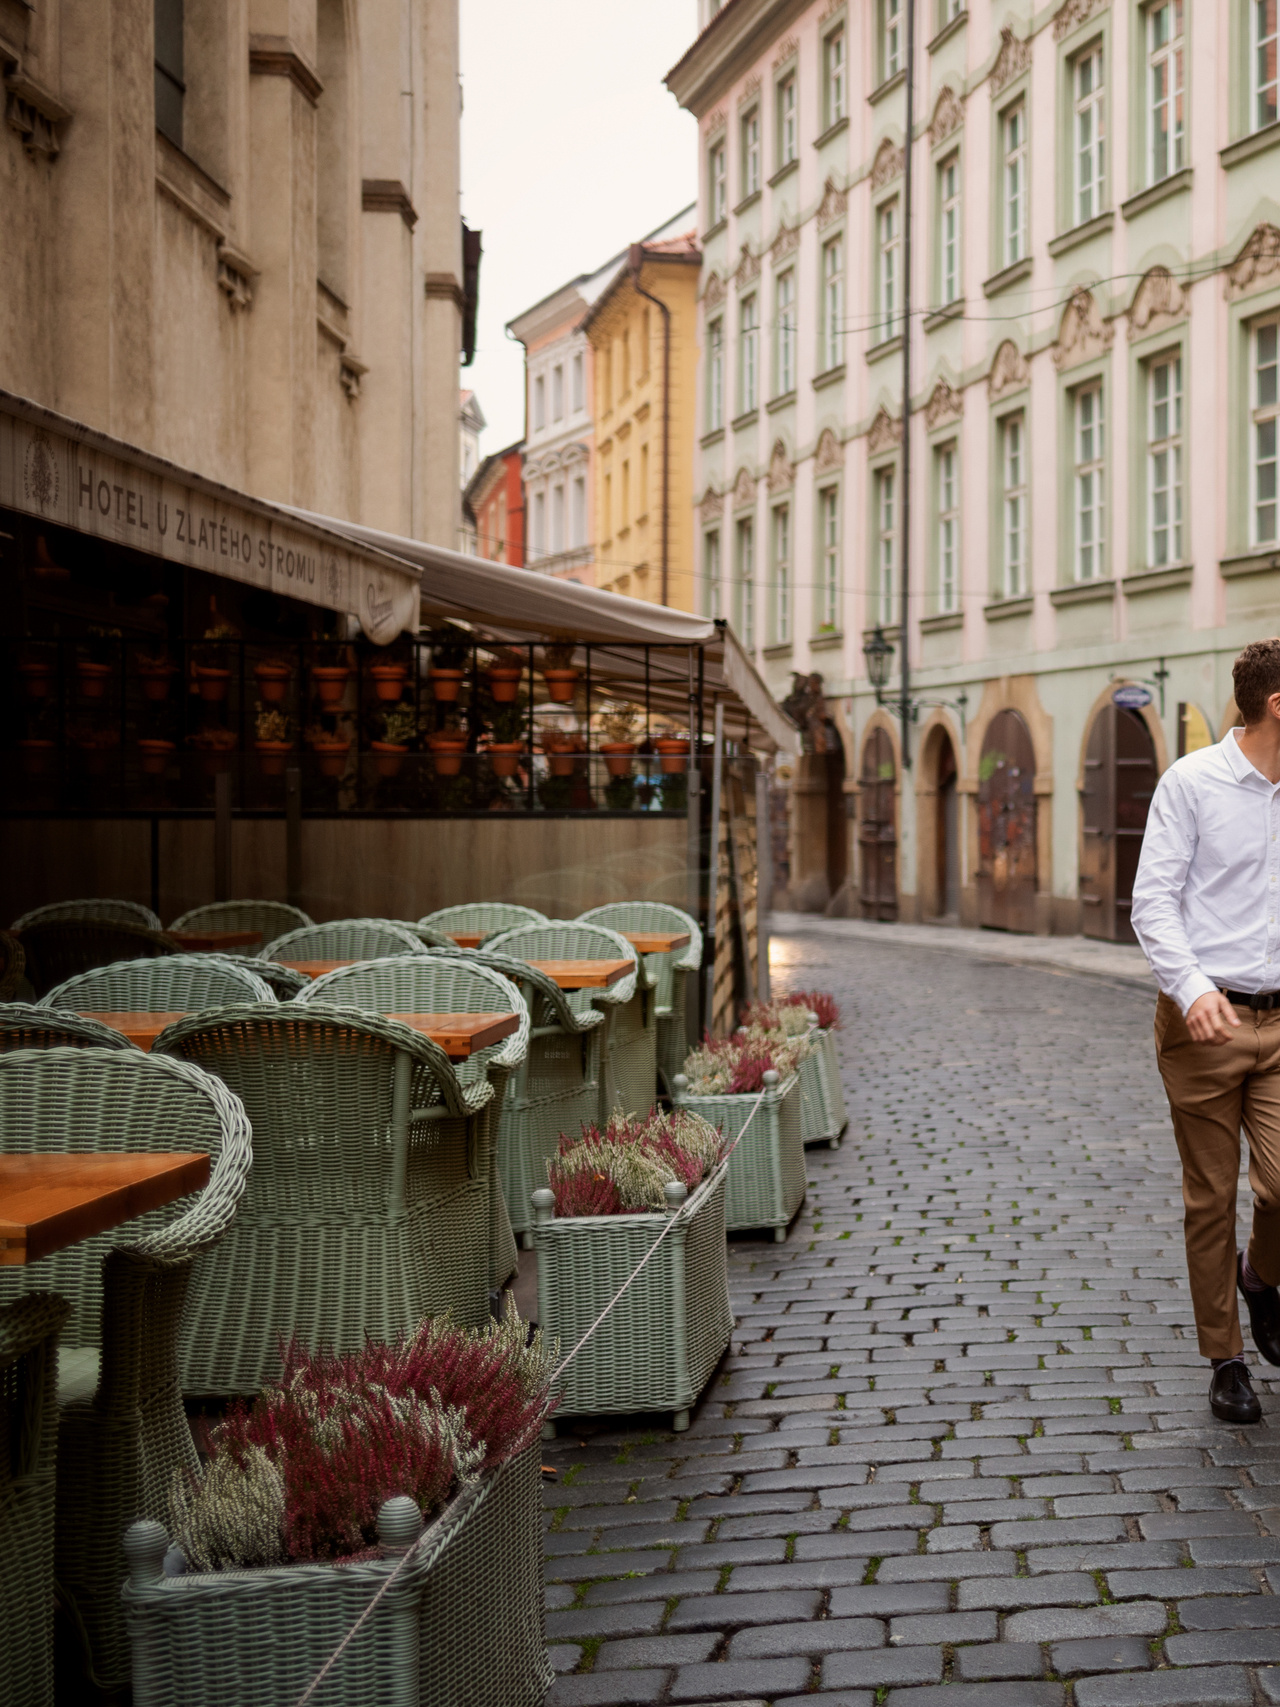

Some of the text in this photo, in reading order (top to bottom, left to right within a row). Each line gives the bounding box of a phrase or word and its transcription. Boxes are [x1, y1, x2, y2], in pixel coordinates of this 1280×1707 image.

[78, 466, 149, 530] HOTEL
[157, 501, 168, 536] U
[176, 508, 251, 564] ZLATÉHO
[258, 540, 316, 585] STROMU
